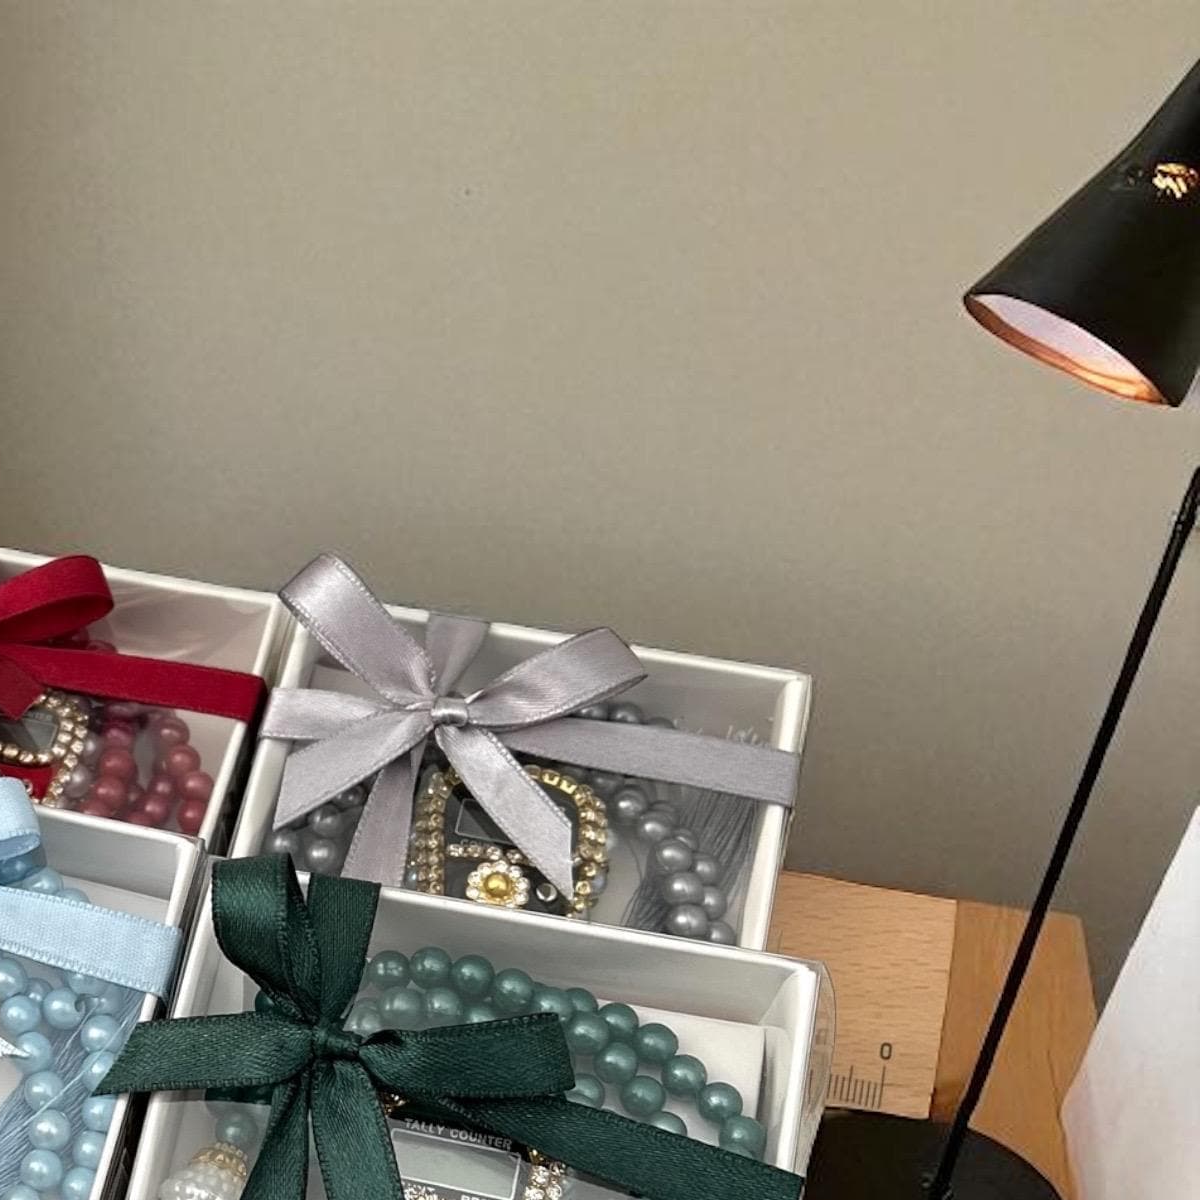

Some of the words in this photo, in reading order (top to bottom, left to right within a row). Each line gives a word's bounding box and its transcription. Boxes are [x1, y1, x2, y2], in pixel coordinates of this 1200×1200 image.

[879, 1042, 893, 1061] 0
[404, 1117, 445, 1136] TALLY
[450, 1128, 513, 1151] COUNTER
